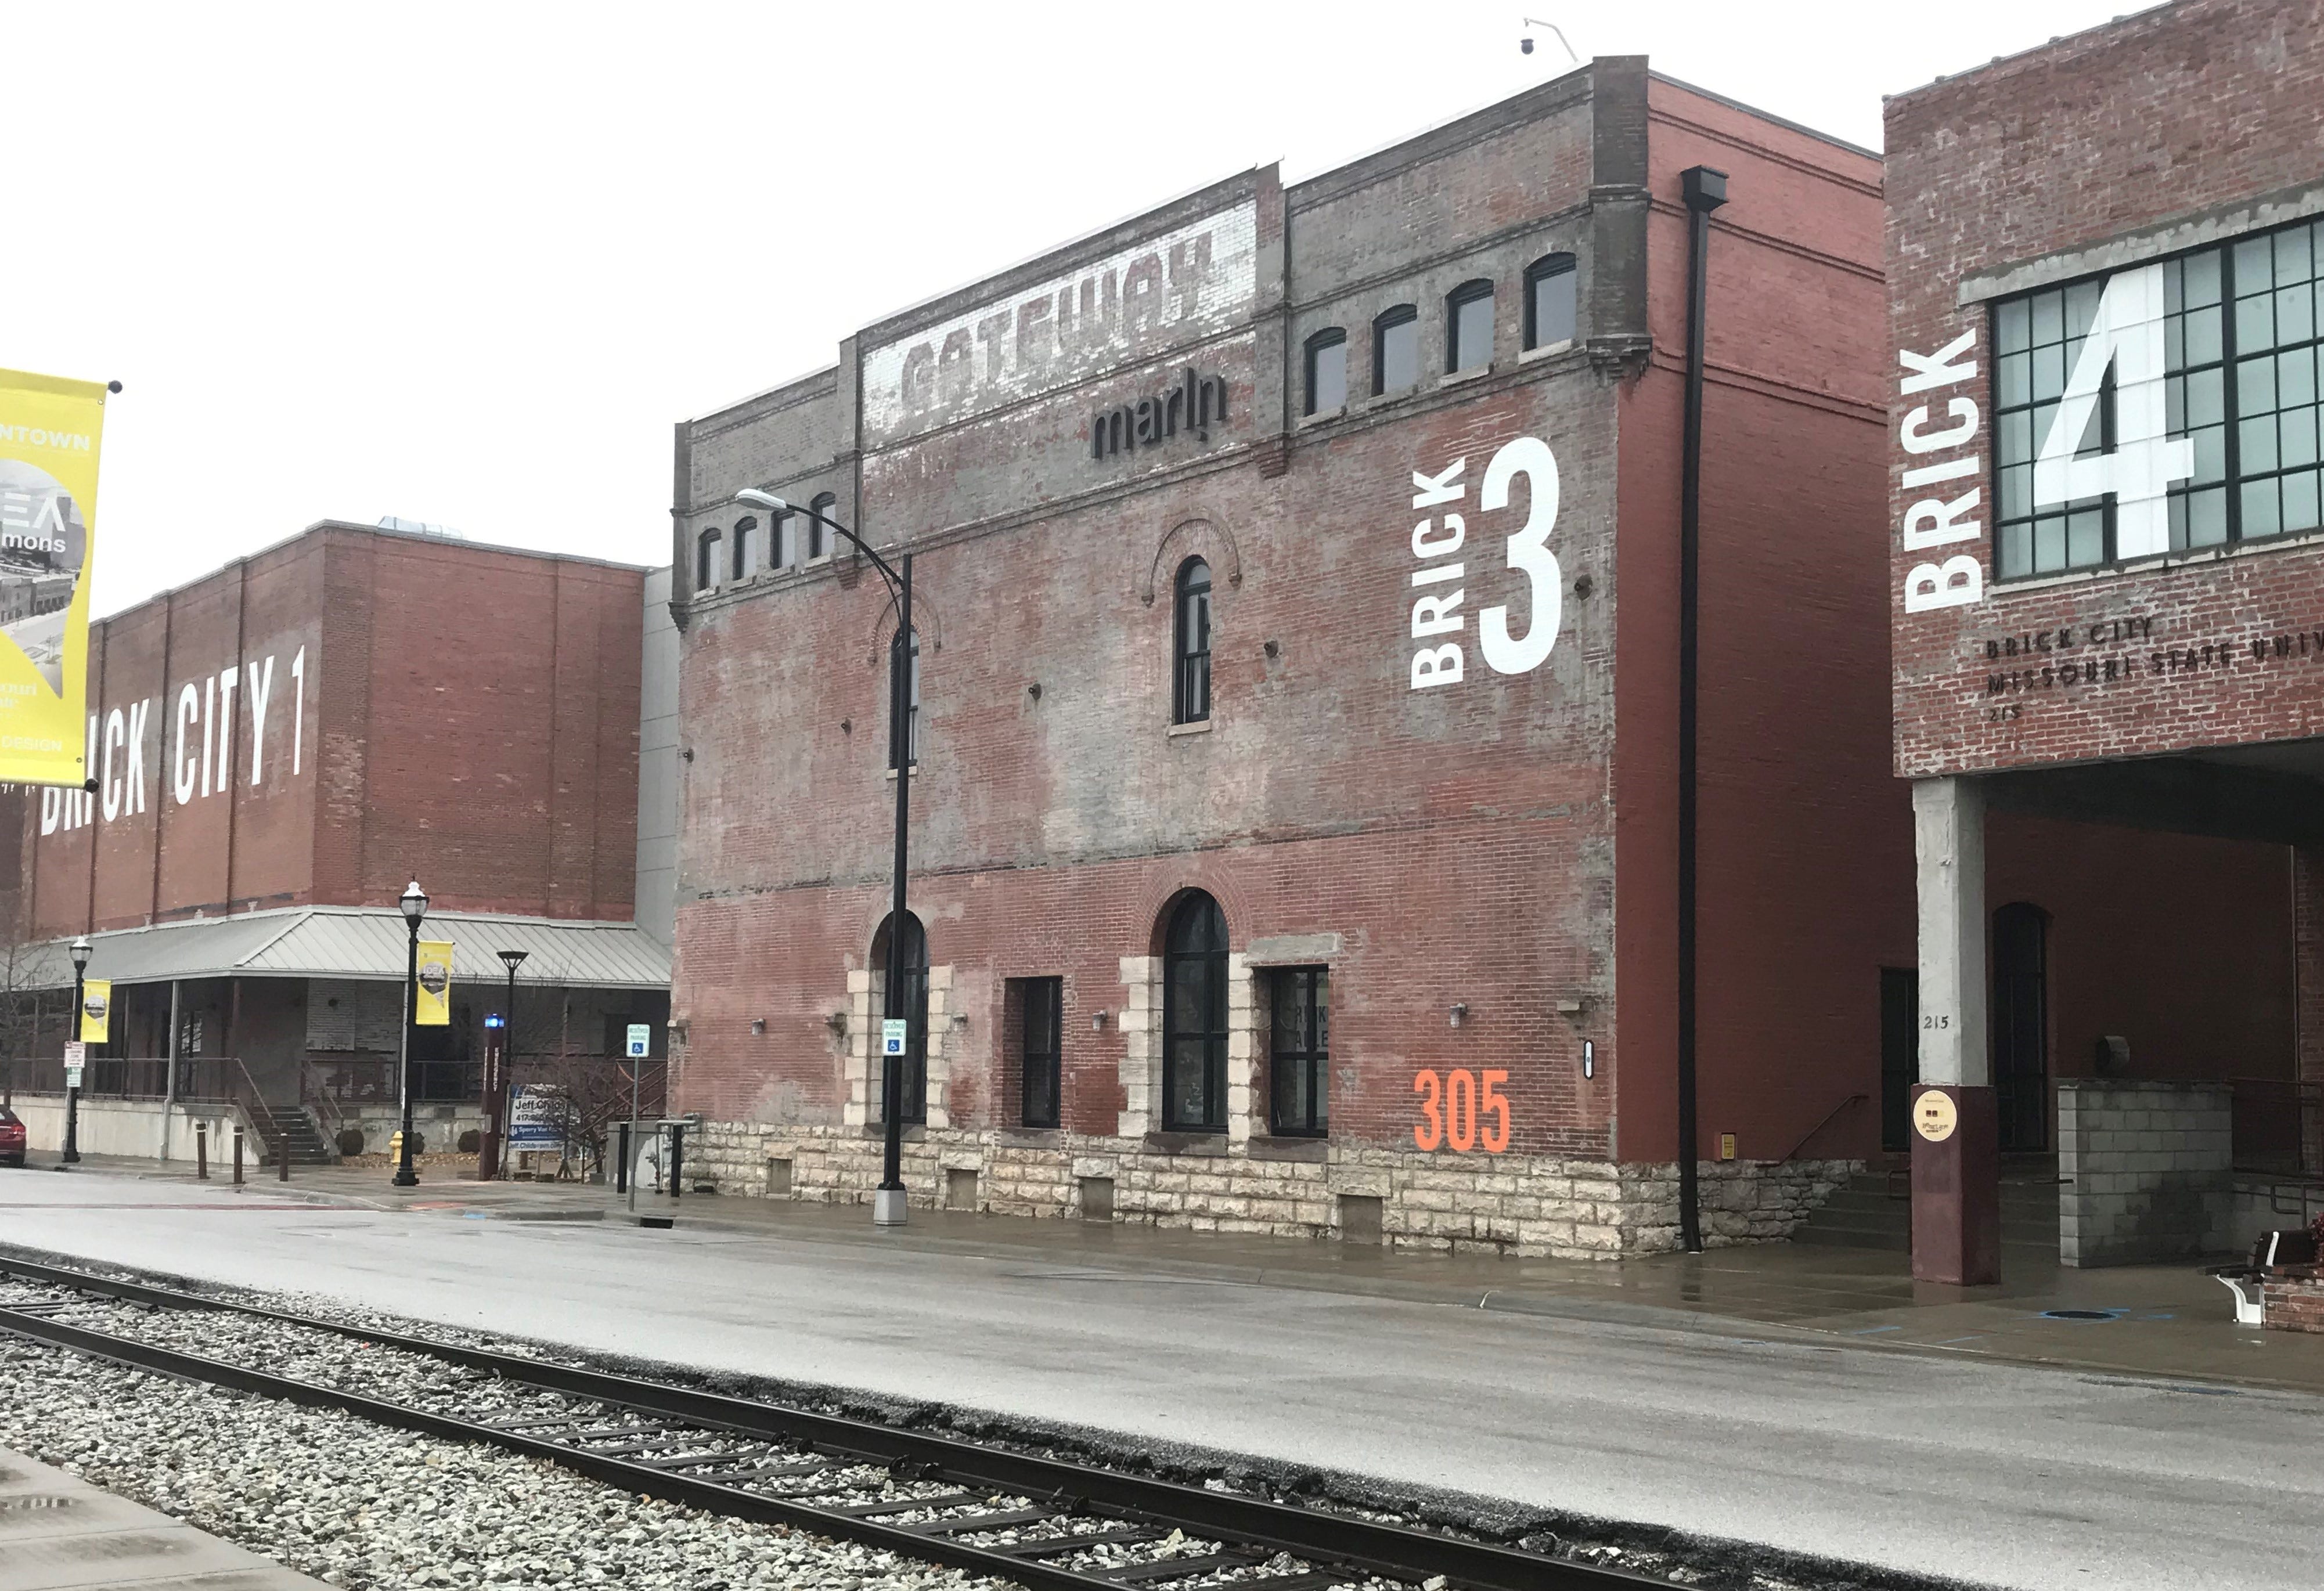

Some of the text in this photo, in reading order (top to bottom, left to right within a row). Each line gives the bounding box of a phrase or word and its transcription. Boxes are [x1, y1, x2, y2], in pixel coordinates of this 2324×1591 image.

[1900, 327, 1983, 614] BRICK
[2034, 262, 2195, 560] 4
[1411, 456, 1465, 689] BRICK
[1479, 436, 1562, 674] 3
[1987, 617, 2151, 658] BRICK CITY
[1988, 656, 2130, 694] MISSOURI
[2152, 643, 2230, 673] STATE
[175, 656, 275, 805] CITY
[292, 644, 305, 775] 1
[1923, 1015, 1949, 1030] 215
[1414, 1069, 1510, 1153] 305
